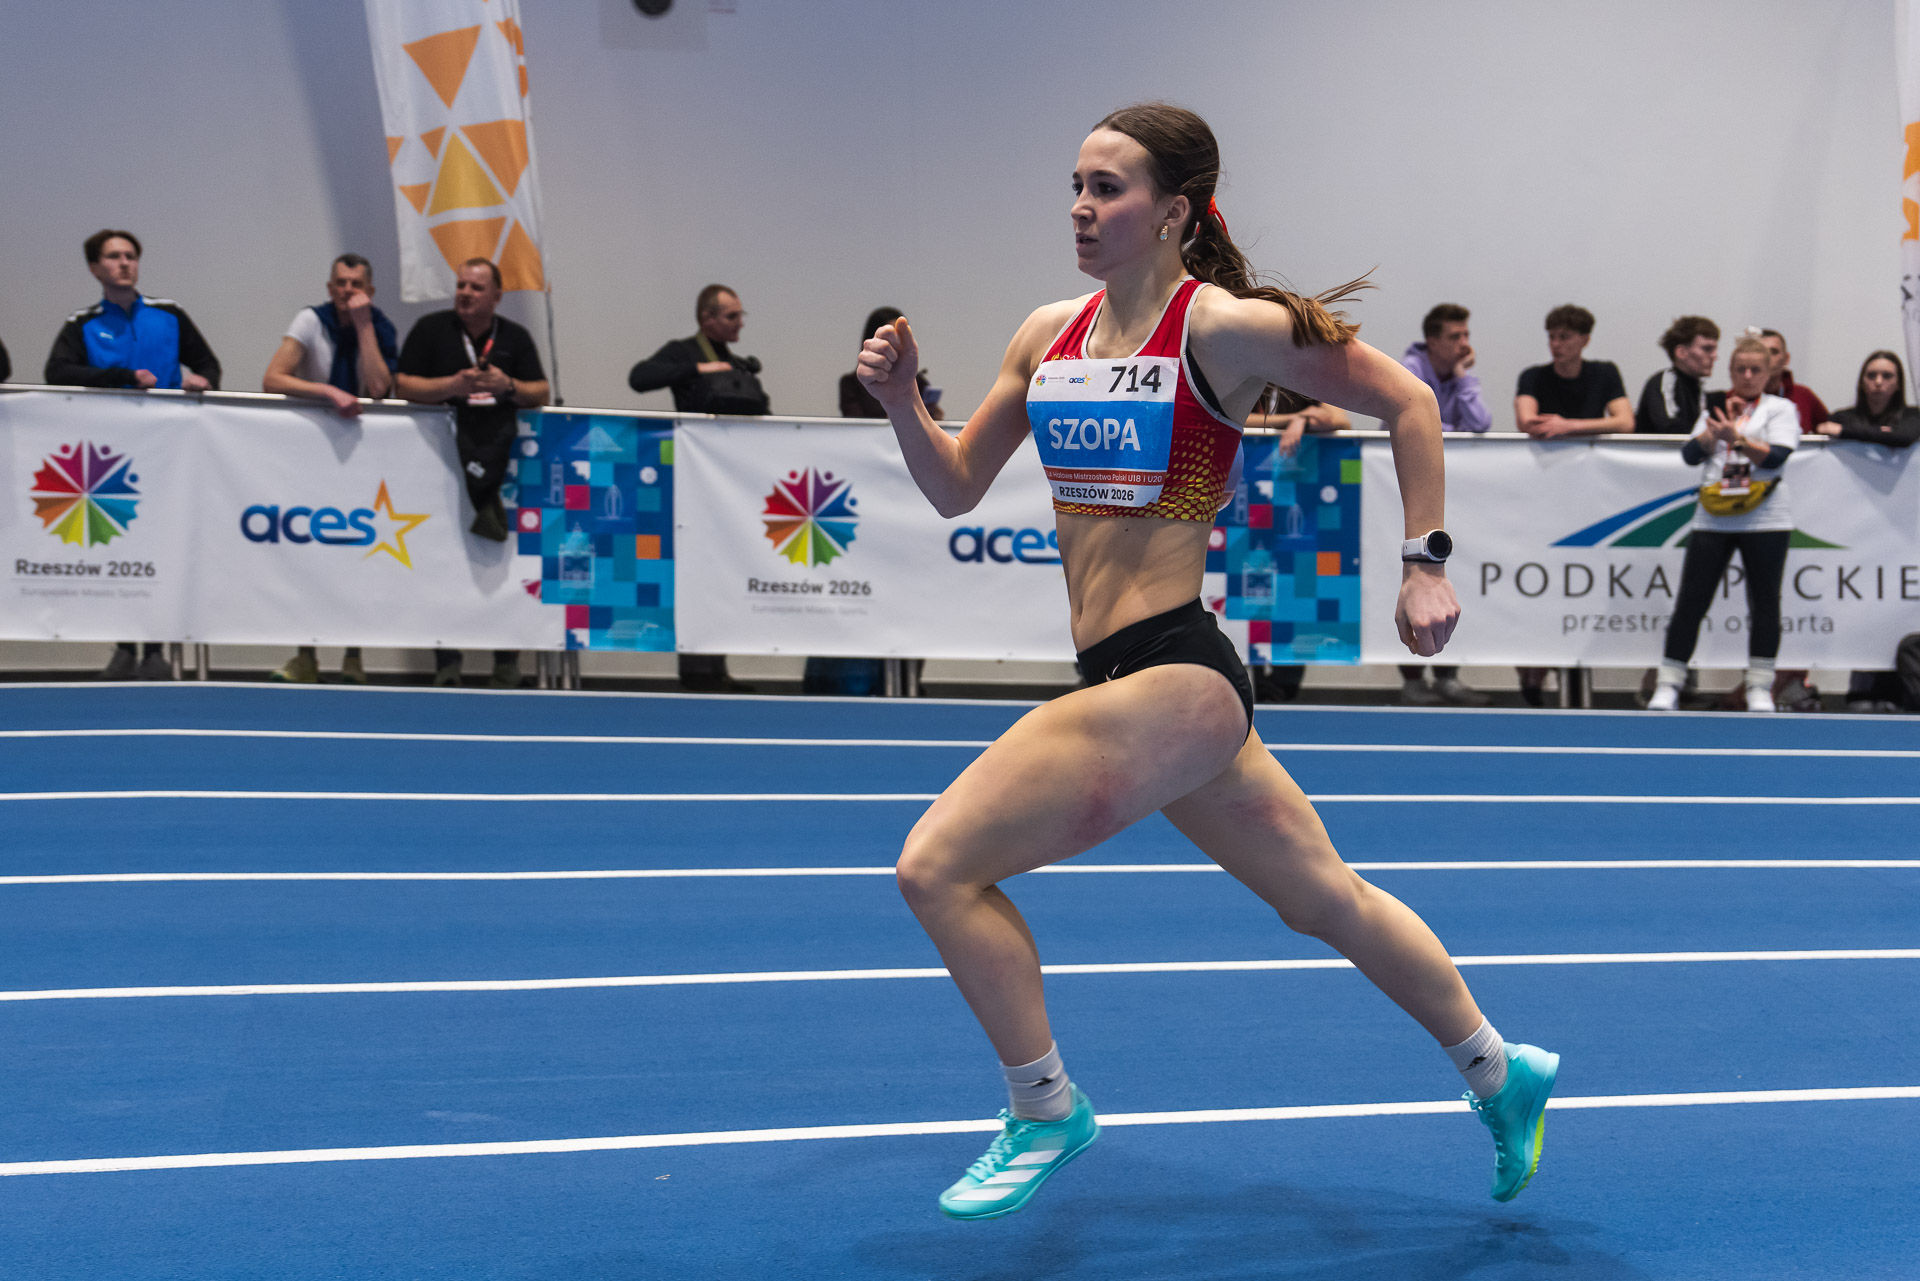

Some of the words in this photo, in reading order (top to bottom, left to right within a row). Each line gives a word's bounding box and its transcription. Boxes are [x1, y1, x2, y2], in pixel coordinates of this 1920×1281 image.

[1108, 364, 1162, 394] 714
[1048, 418, 1141, 452] SZOPA
[1074, 472, 1112, 482] Mistrzostwa
[1112, 473, 1127, 482] Polski
[1128, 474, 1142, 483] U18
[1147, 475, 1163, 483] U20
[1059, 485, 1109, 500] RZESZÓW
[1111, 488, 1135, 501] 2026
[240, 504, 376, 546] aces
[15, 558, 102, 576] Rzeszów
[107, 560, 156, 577] 2026
[748, 577, 824, 594] Rzeszów
[829, 580, 872, 596] 2026
[1480, 561, 1920, 601] PODKAPCKIE
